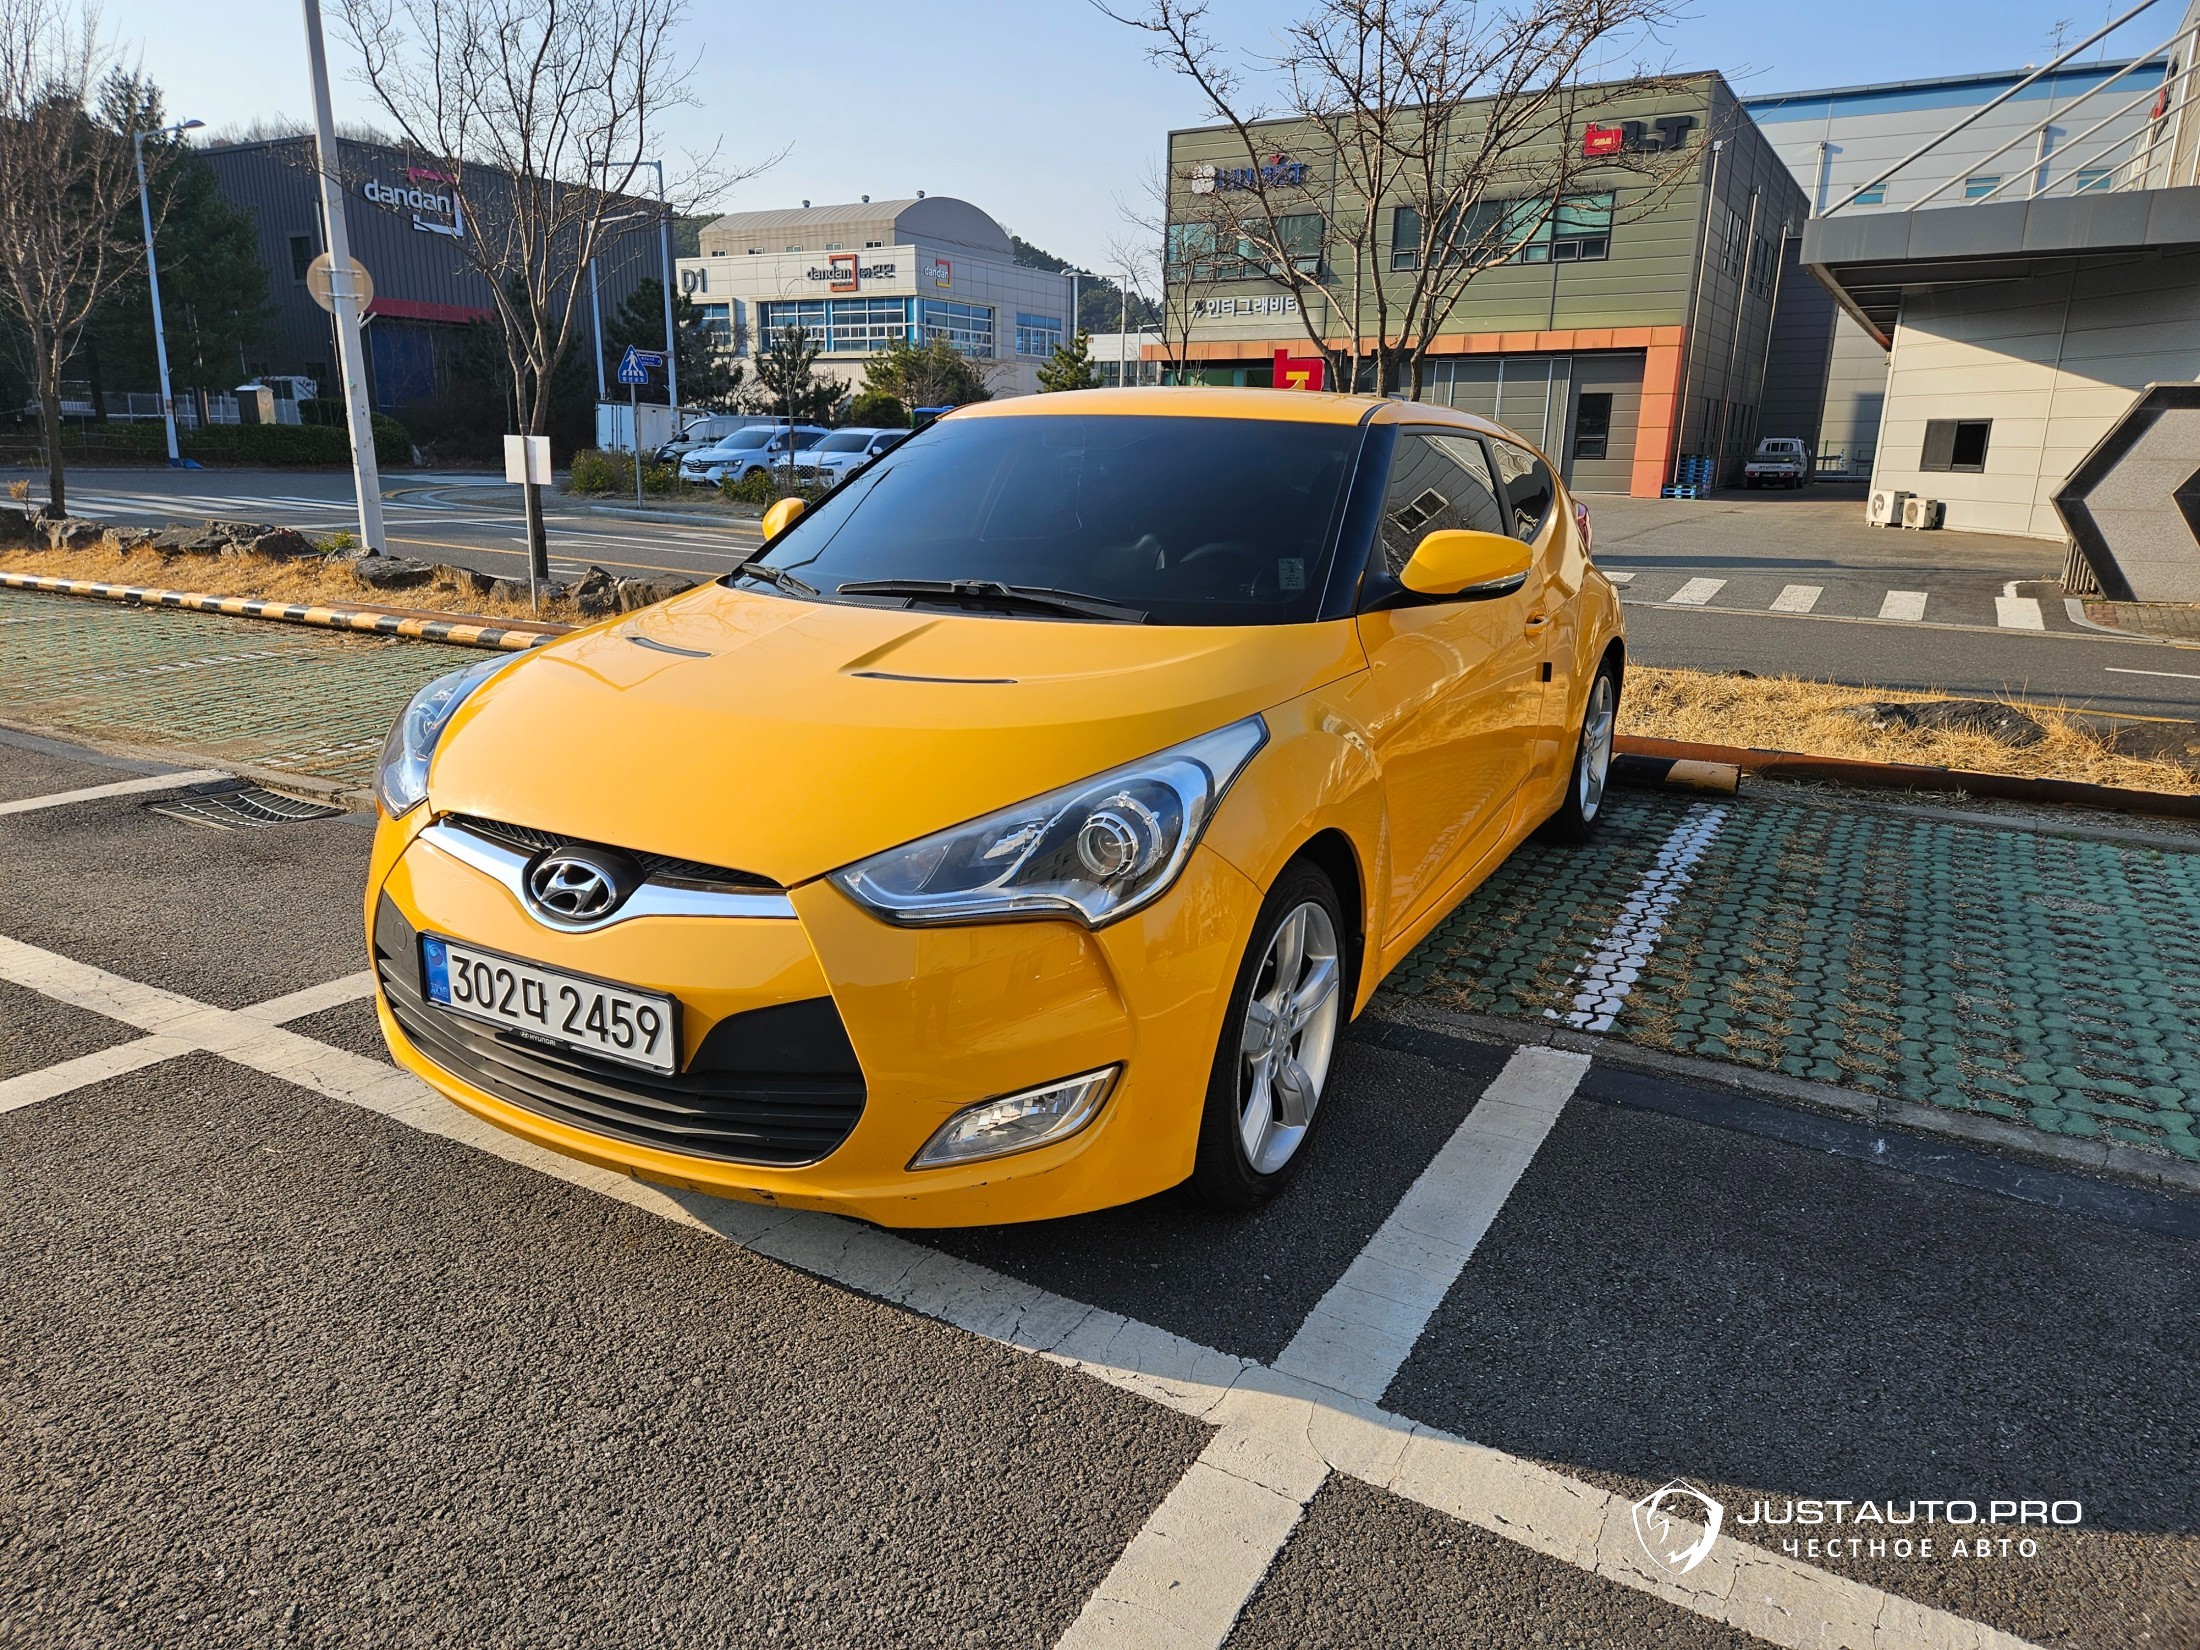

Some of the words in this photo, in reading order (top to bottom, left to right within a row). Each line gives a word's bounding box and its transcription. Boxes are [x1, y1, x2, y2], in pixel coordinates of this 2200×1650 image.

[364, 178, 451, 213] dandan
[681, 268, 706, 293] D1
[807, 266, 852, 280] dandan
[924, 265, 949, 279] dandan
[1206, 296, 1301, 318] 인터그래비티
[451, 954, 550, 1025] 302다
[558, 984, 661, 1055] 2459
[529, 1033, 556, 1047] HYUNDAI
